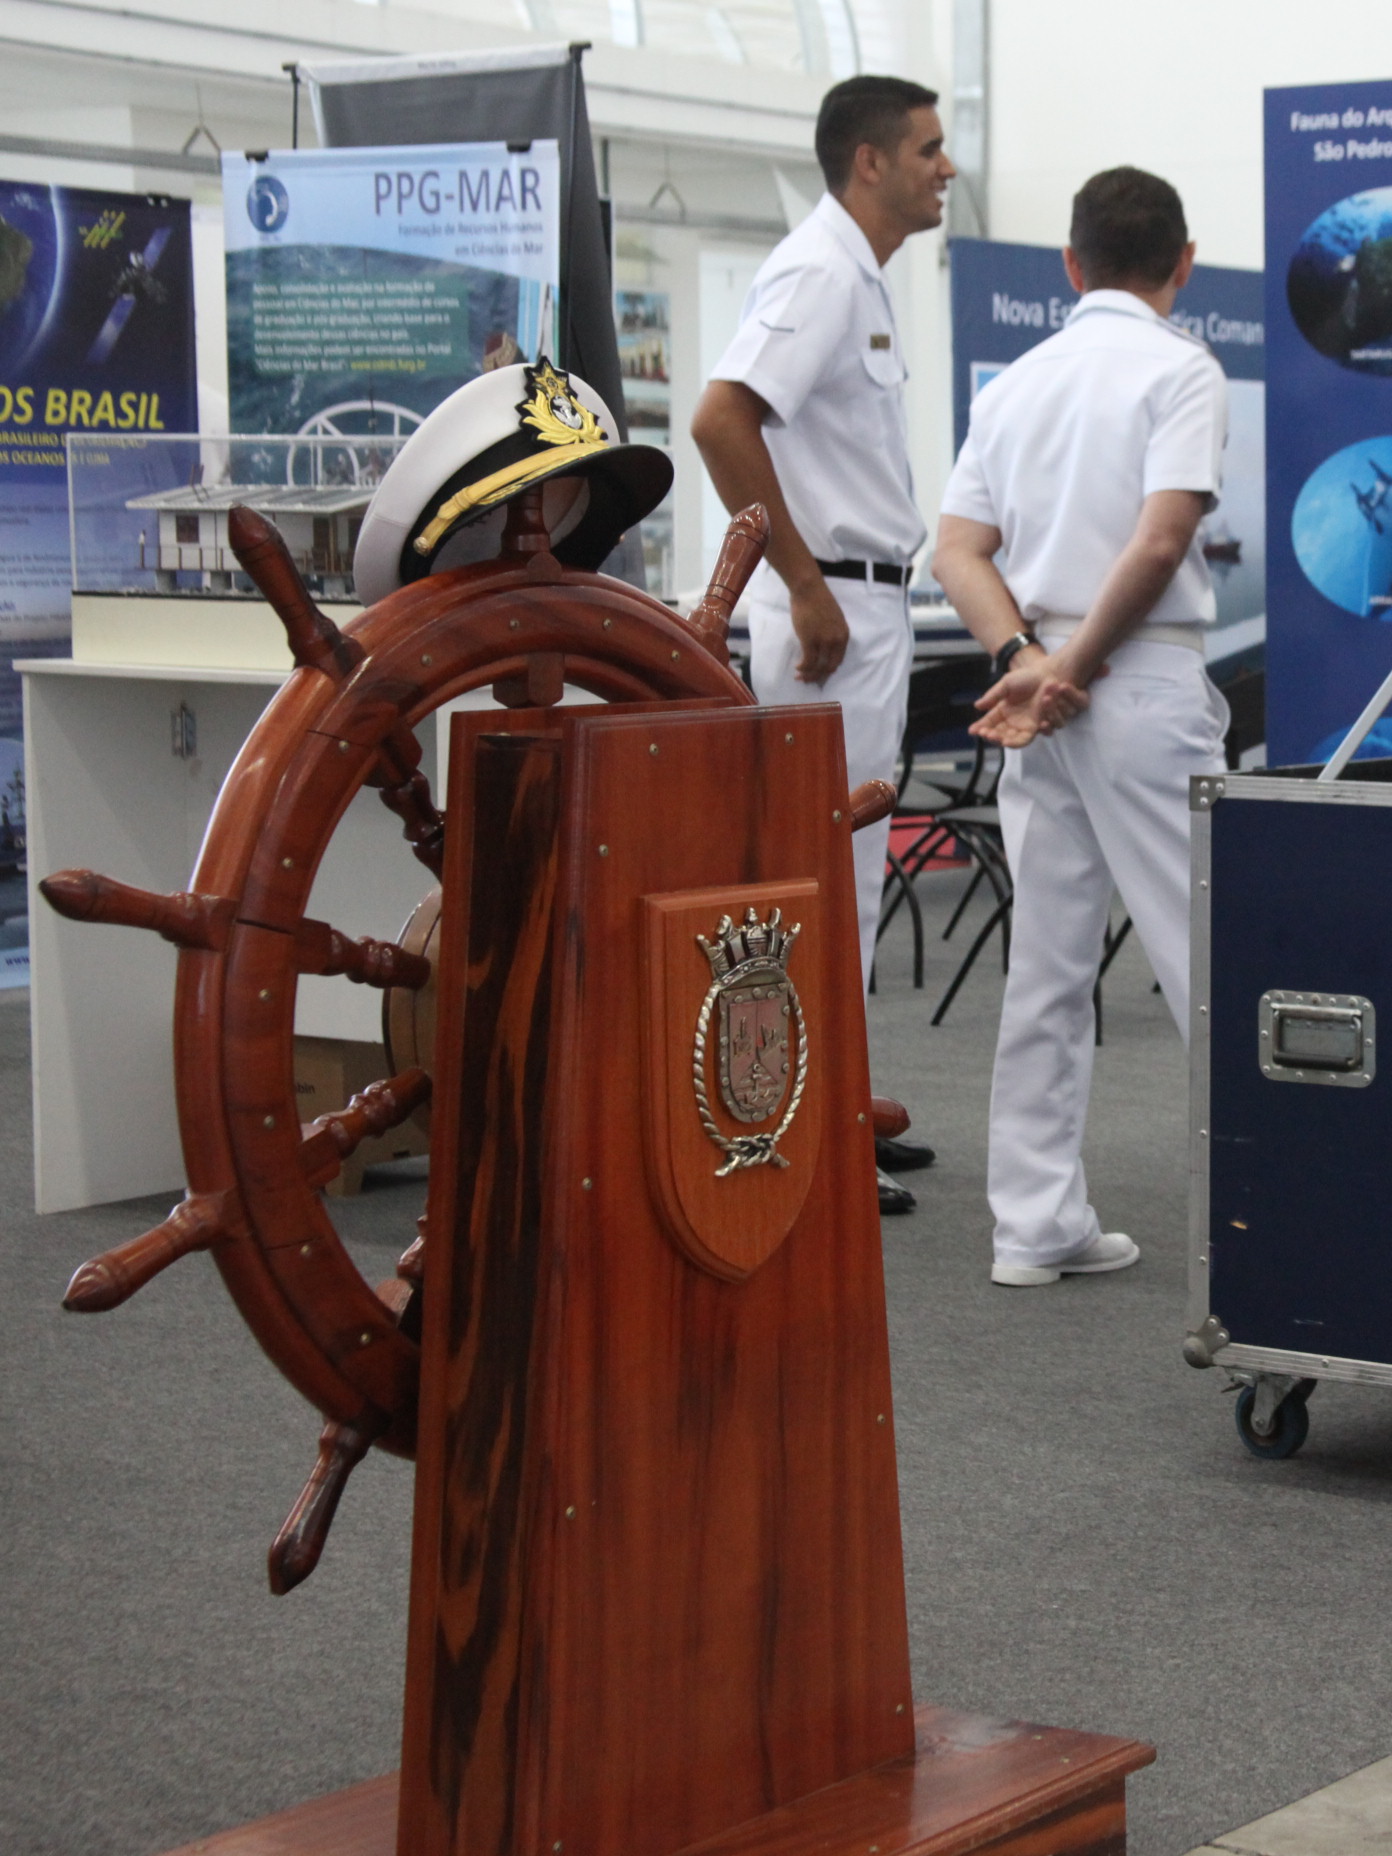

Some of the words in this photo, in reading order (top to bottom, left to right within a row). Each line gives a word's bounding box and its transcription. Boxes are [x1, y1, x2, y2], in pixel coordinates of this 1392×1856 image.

[1289, 111, 1340, 132] Fauna
[1341, 107, 1364, 128] do
[1313, 140, 1345, 162] São
[374, 167, 543, 216] PPG-MAR
[992, 292, 1044, 329] Nova
[1206, 312, 1265, 346] Coman
[44, 387, 165, 430] BRASIL
